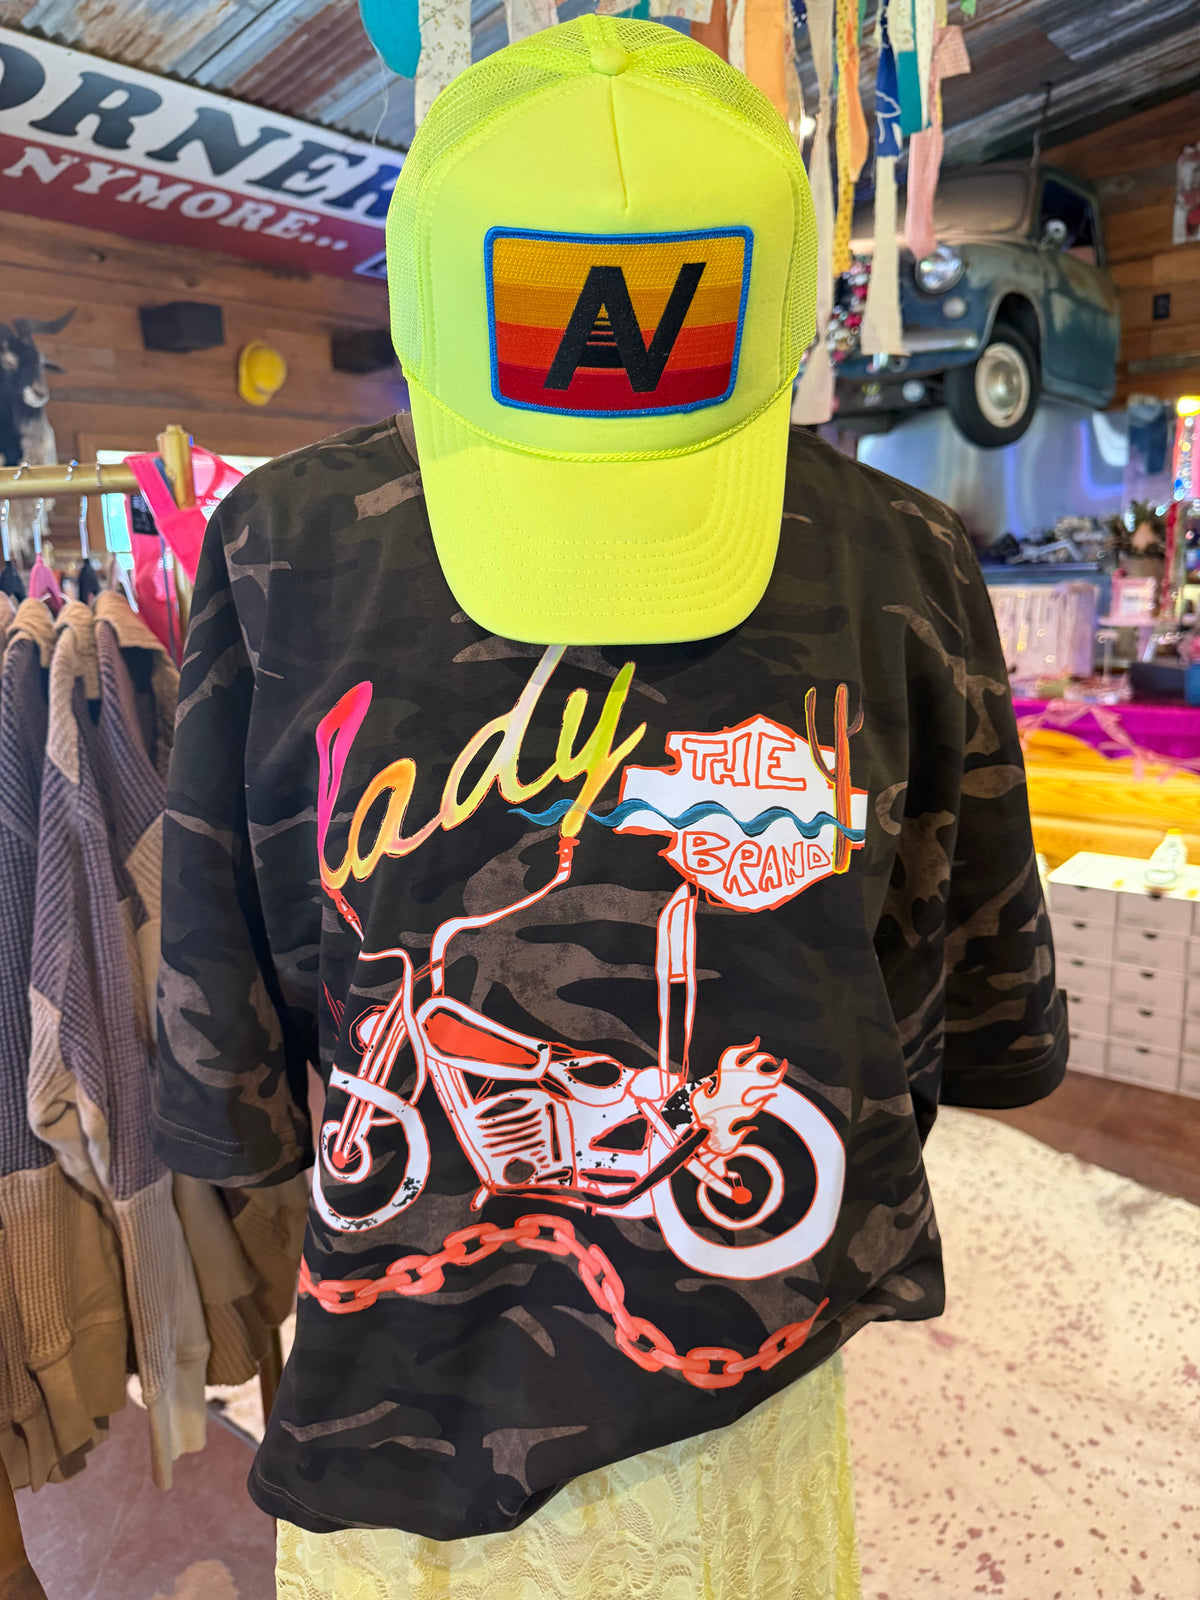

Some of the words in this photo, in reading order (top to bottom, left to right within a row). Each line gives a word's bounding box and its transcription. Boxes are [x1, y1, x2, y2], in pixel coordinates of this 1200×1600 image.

[542, 261, 707, 393] AV
[682, 732, 807, 791] THE
[683, 831, 831, 897] BRAND
